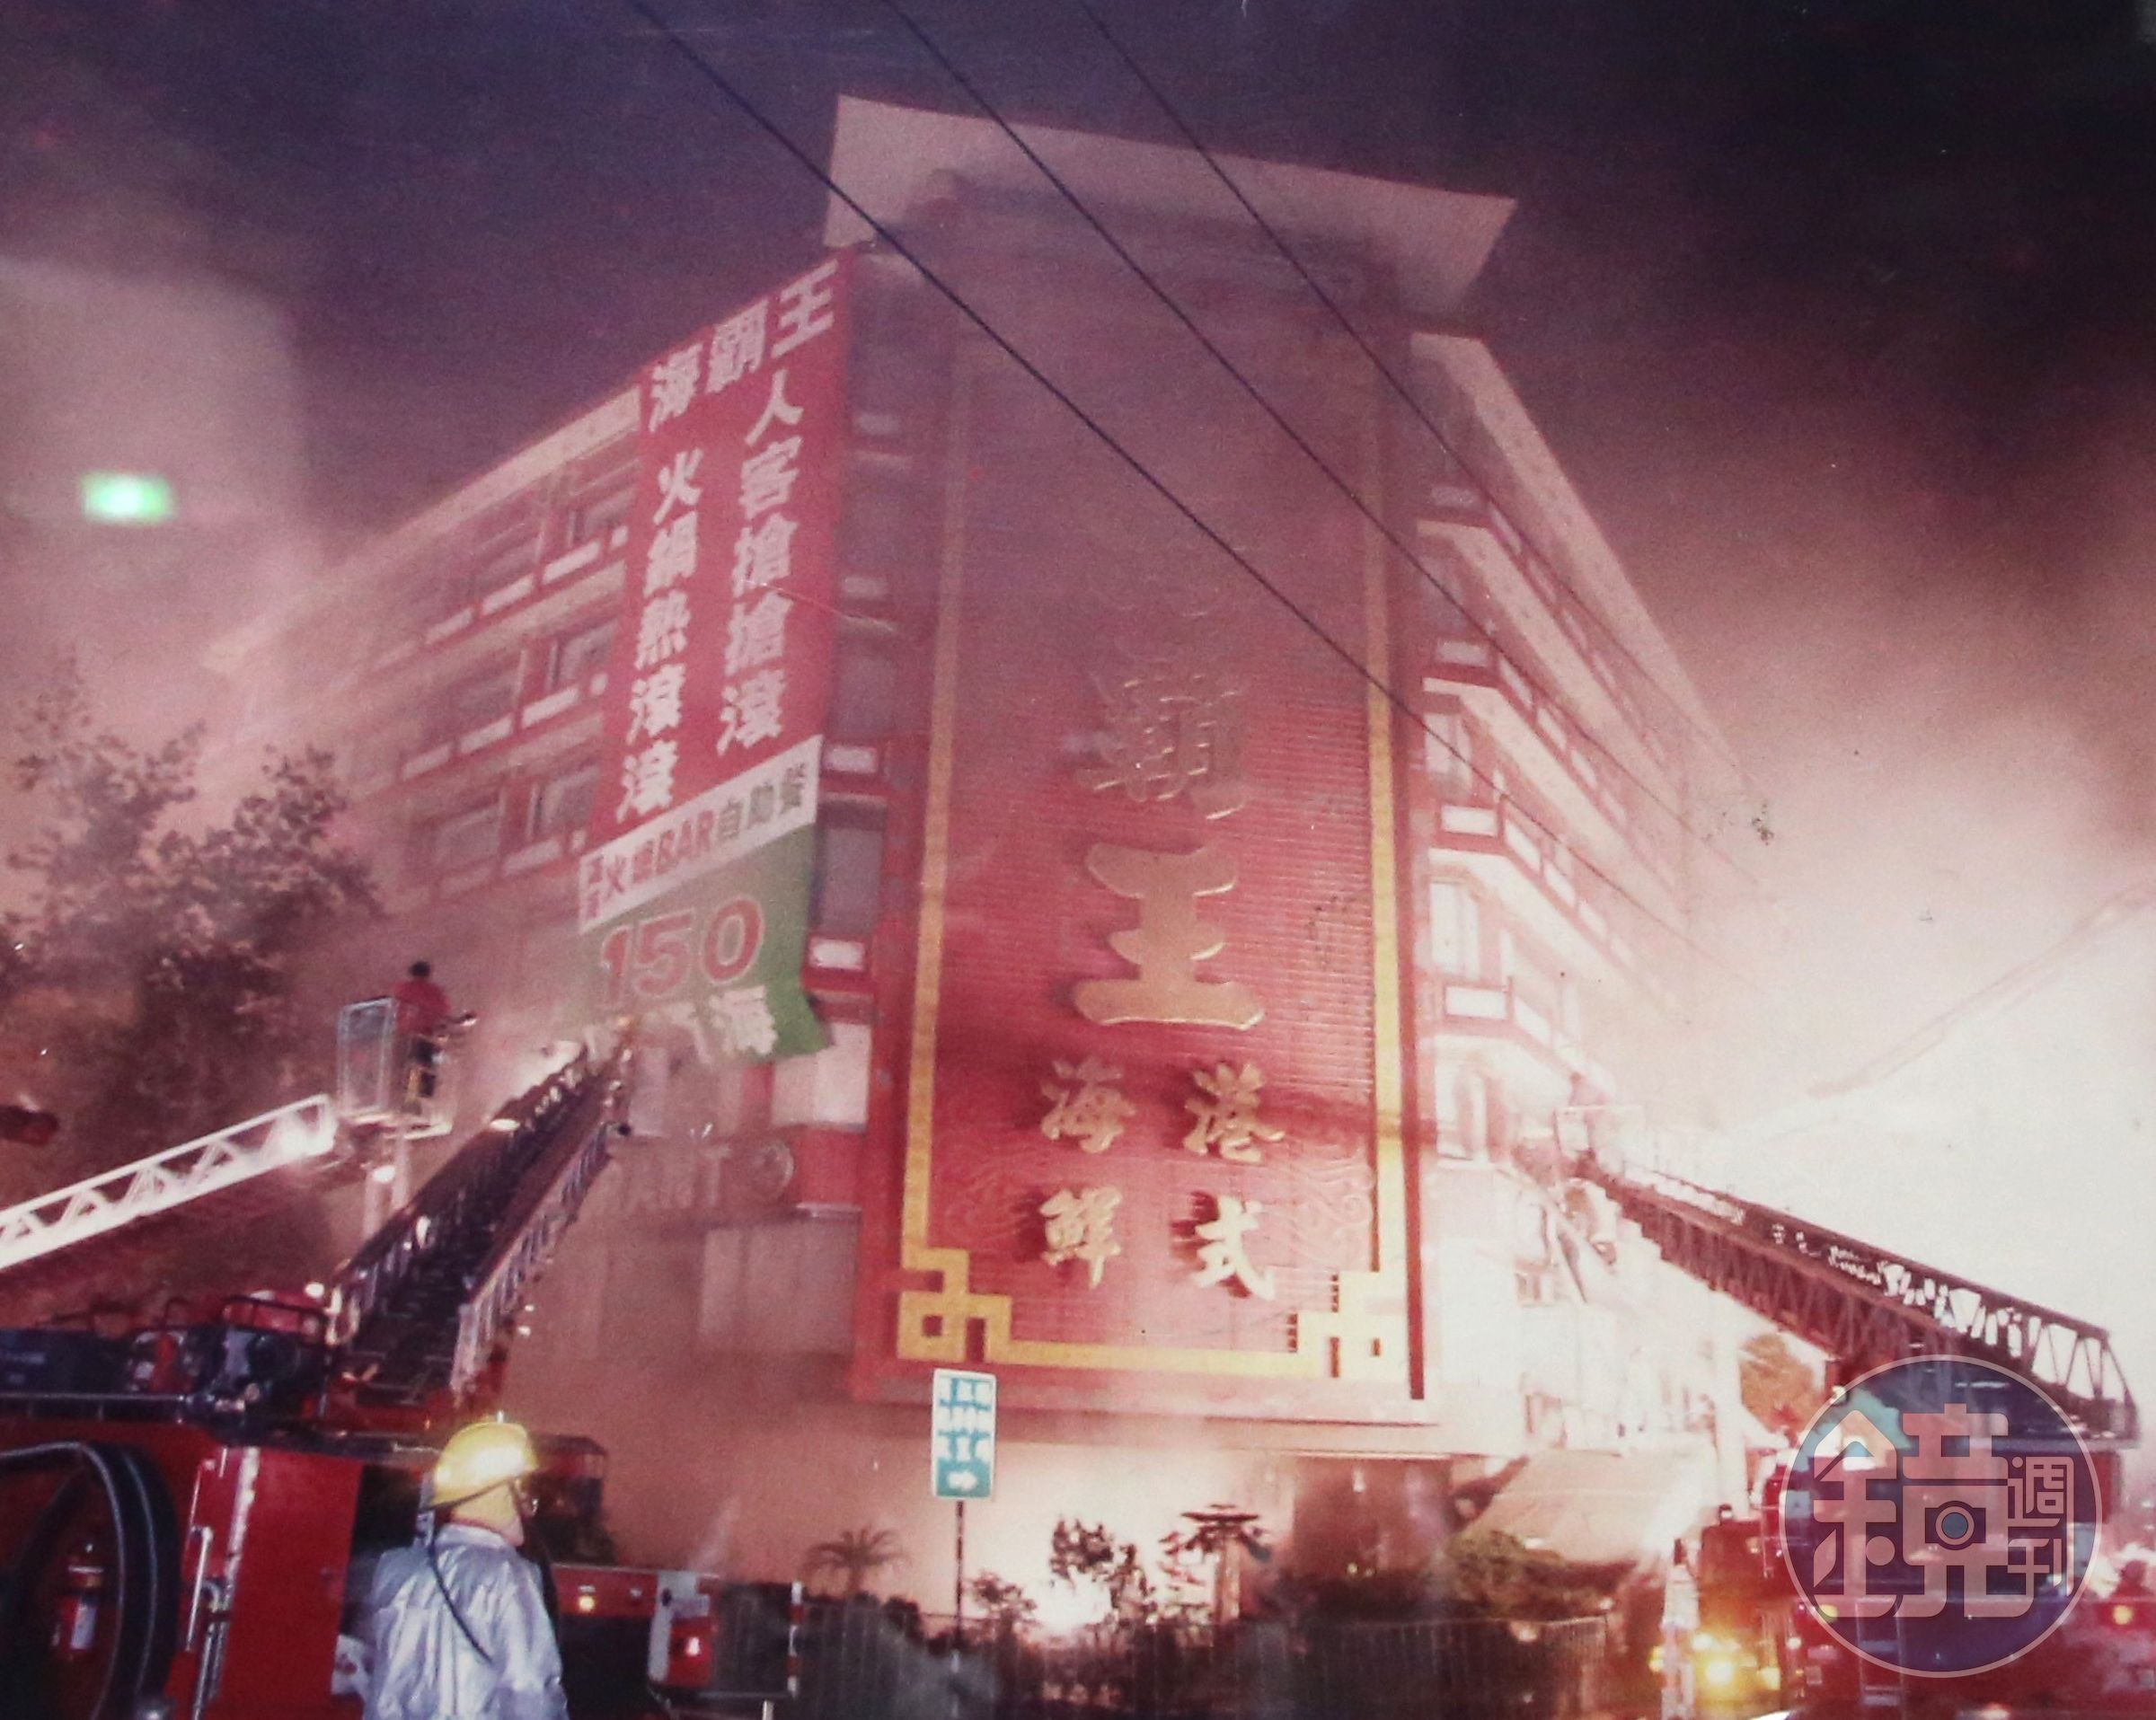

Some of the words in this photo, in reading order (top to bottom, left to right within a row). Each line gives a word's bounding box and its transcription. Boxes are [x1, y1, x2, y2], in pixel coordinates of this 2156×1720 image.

[648, 258, 838, 434] 海霸王
[616, 449, 703, 824] 火鍋熱滾滾
[599, 895, 765, 1011] 150
